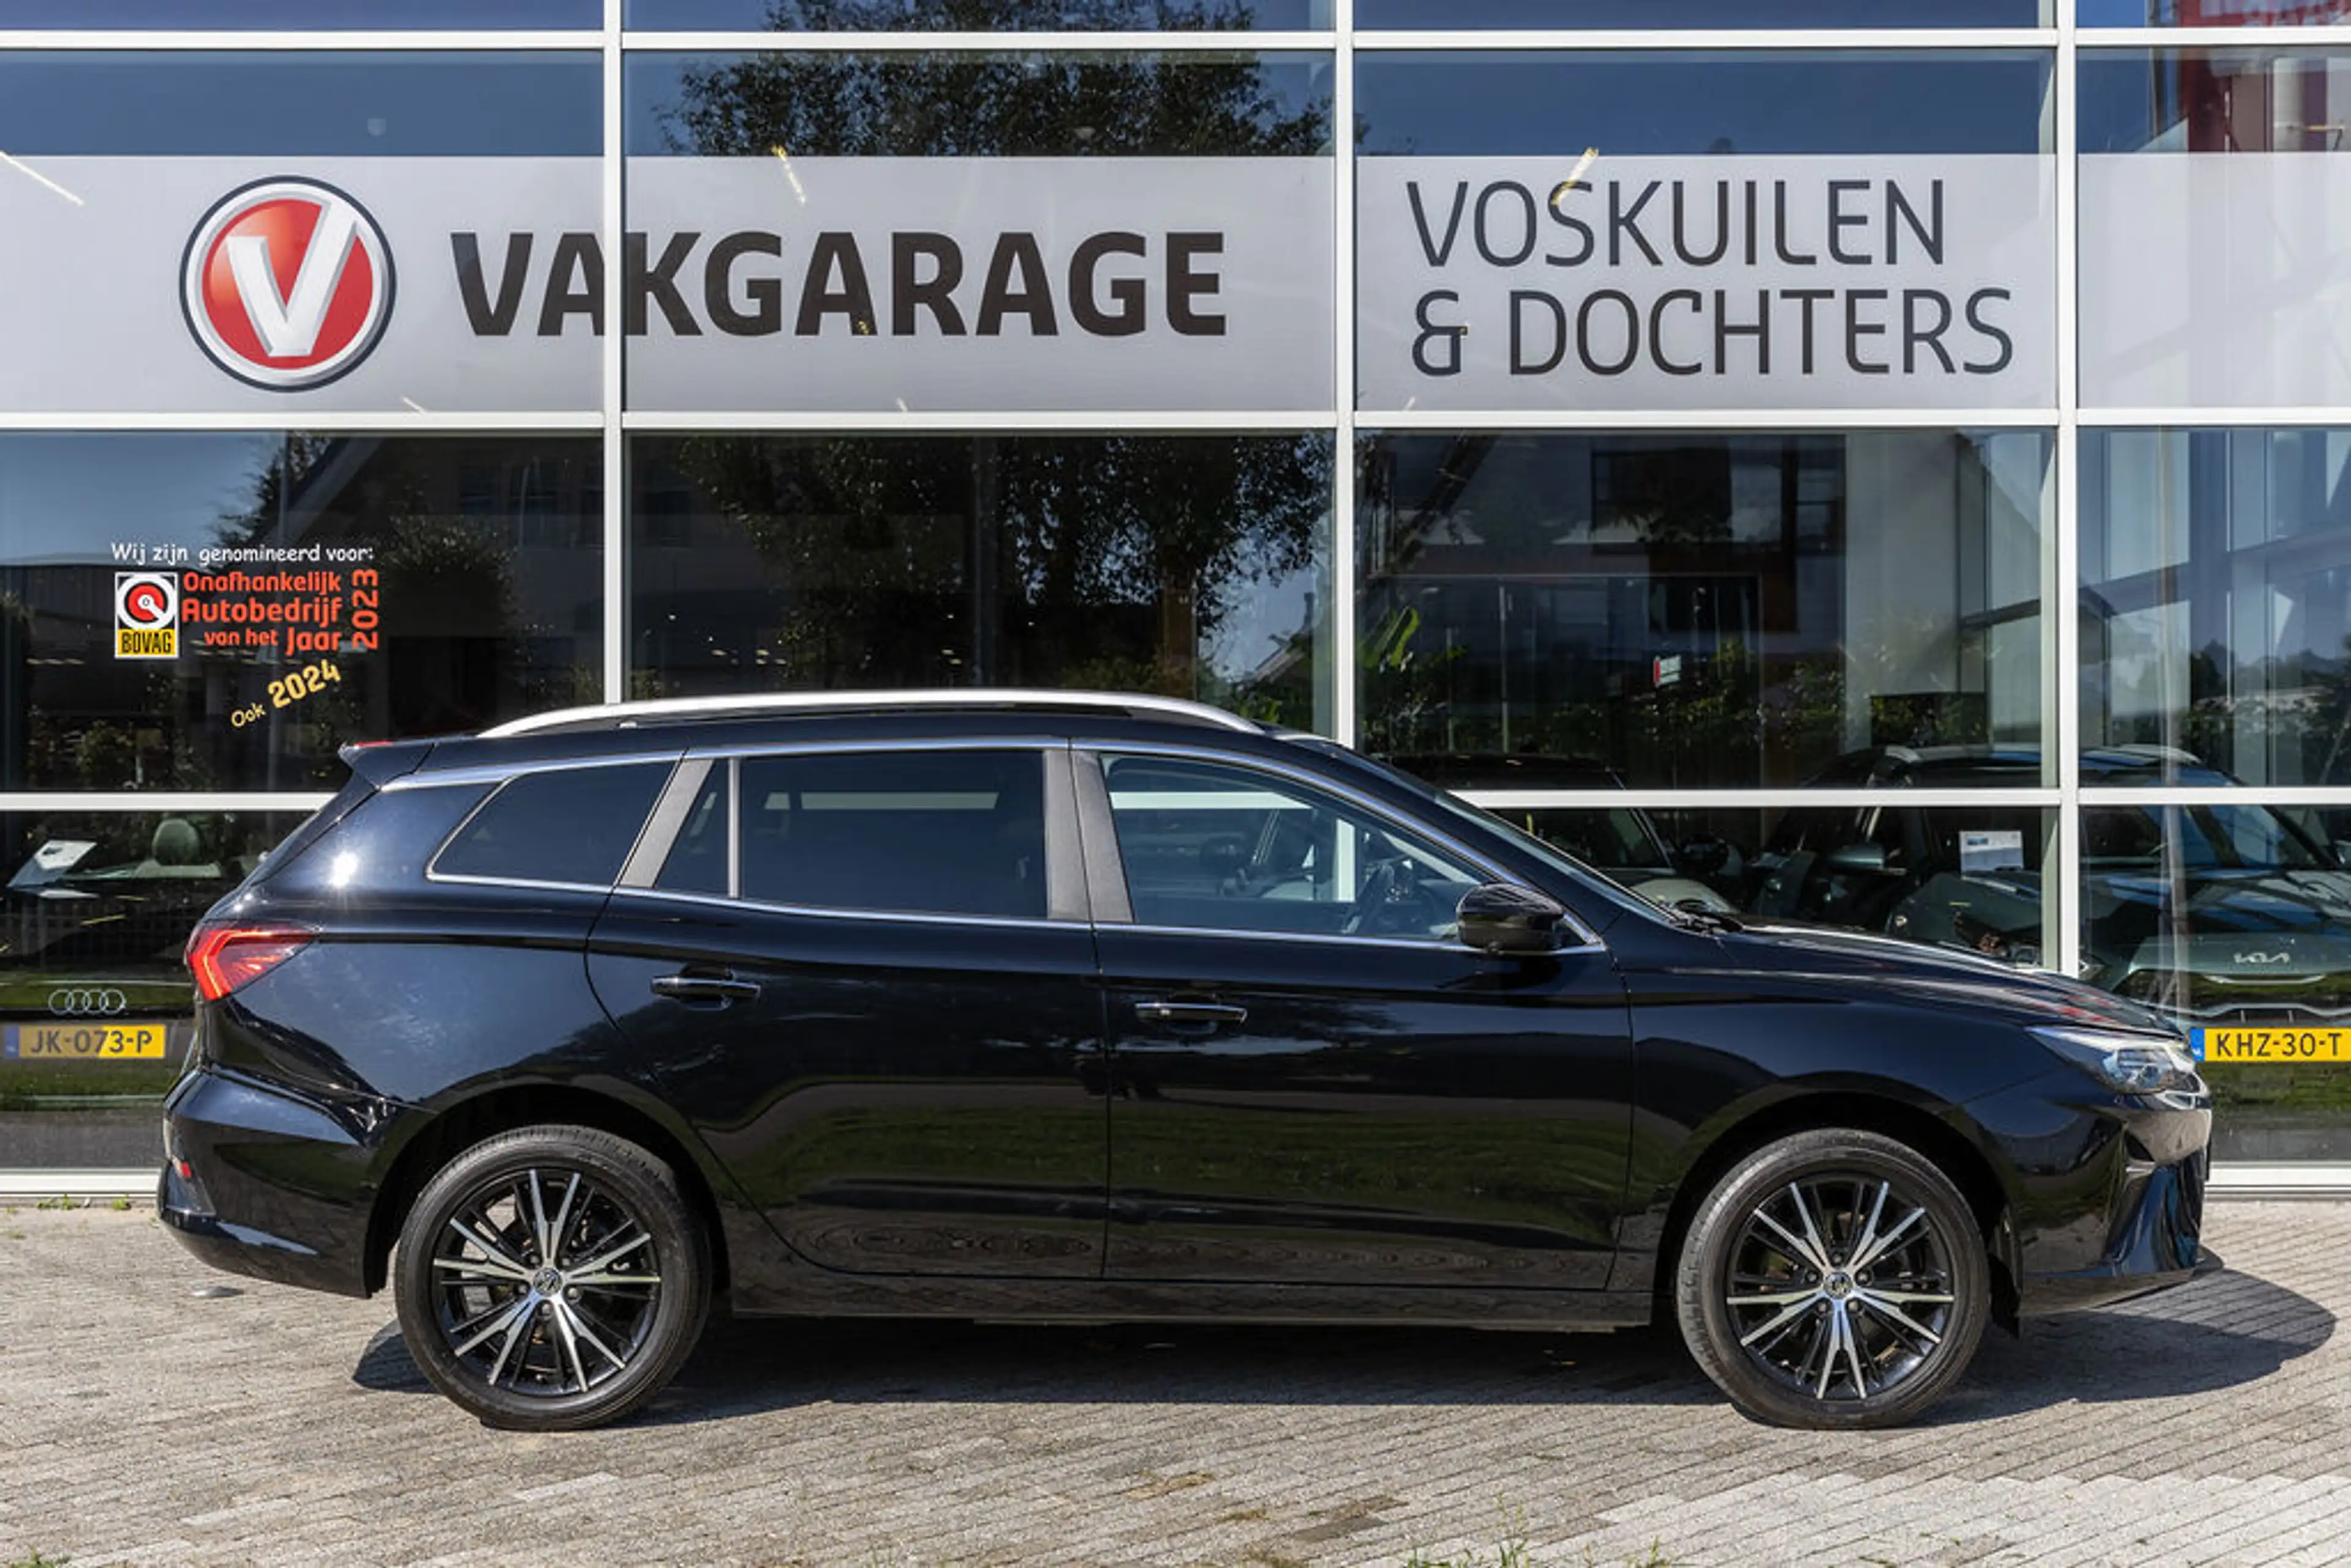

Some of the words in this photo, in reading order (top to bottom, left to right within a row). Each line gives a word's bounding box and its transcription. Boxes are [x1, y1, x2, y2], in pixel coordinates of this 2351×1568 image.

[1407, 179, 1943, 266] VOSKUILEN
[450, 230, 1227, 336] VAKGARAGE
[1412, 289, 1468, 375] &
[1509, 288, 2013, 375] DOCHTERS
[111, 542, 147, 566] Wij
[152, 544, 189, 566] zijn
[199, 543, 321, 566] genomineerd
[326, 545, 374, 563] voor:
[183, 571, 342, 596] Onafhankelijk
[181, 597, 343, 628] Autobedrijf
[351, 568, 379, 650] 2023
[121, 631, 172, 653] BOVAG
[204, 631, 240, 646] van
[245, 628, 279, 646] het
[285, 628, 342, 656] Jaar
[230, 702, 266, 727] Ook
[268, 659, 342, 709] 2024
[31, 1030, 152, 1053] JK-073-P
[2216, 1032, 2342, 1057] KHZ-30-T
